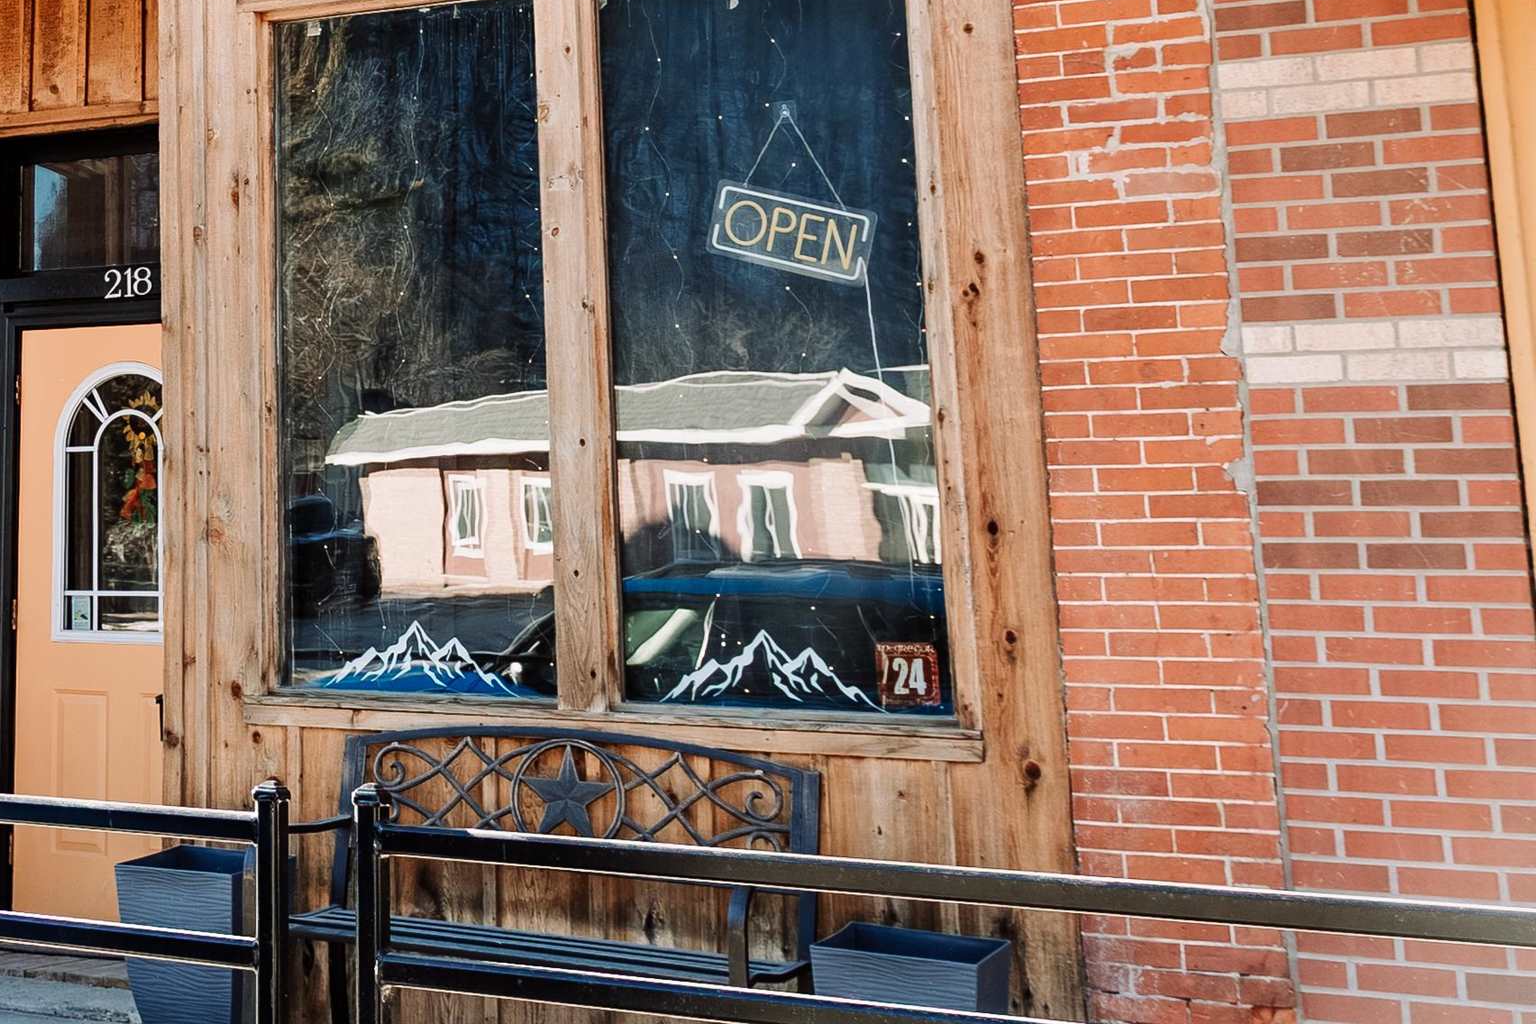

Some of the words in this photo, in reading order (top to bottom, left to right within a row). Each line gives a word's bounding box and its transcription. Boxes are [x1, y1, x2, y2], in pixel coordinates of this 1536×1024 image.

[724, 200, 858, 270] OPEN
[104, 266, 153, 299] 218
[892, 657, 927, 695] 24
